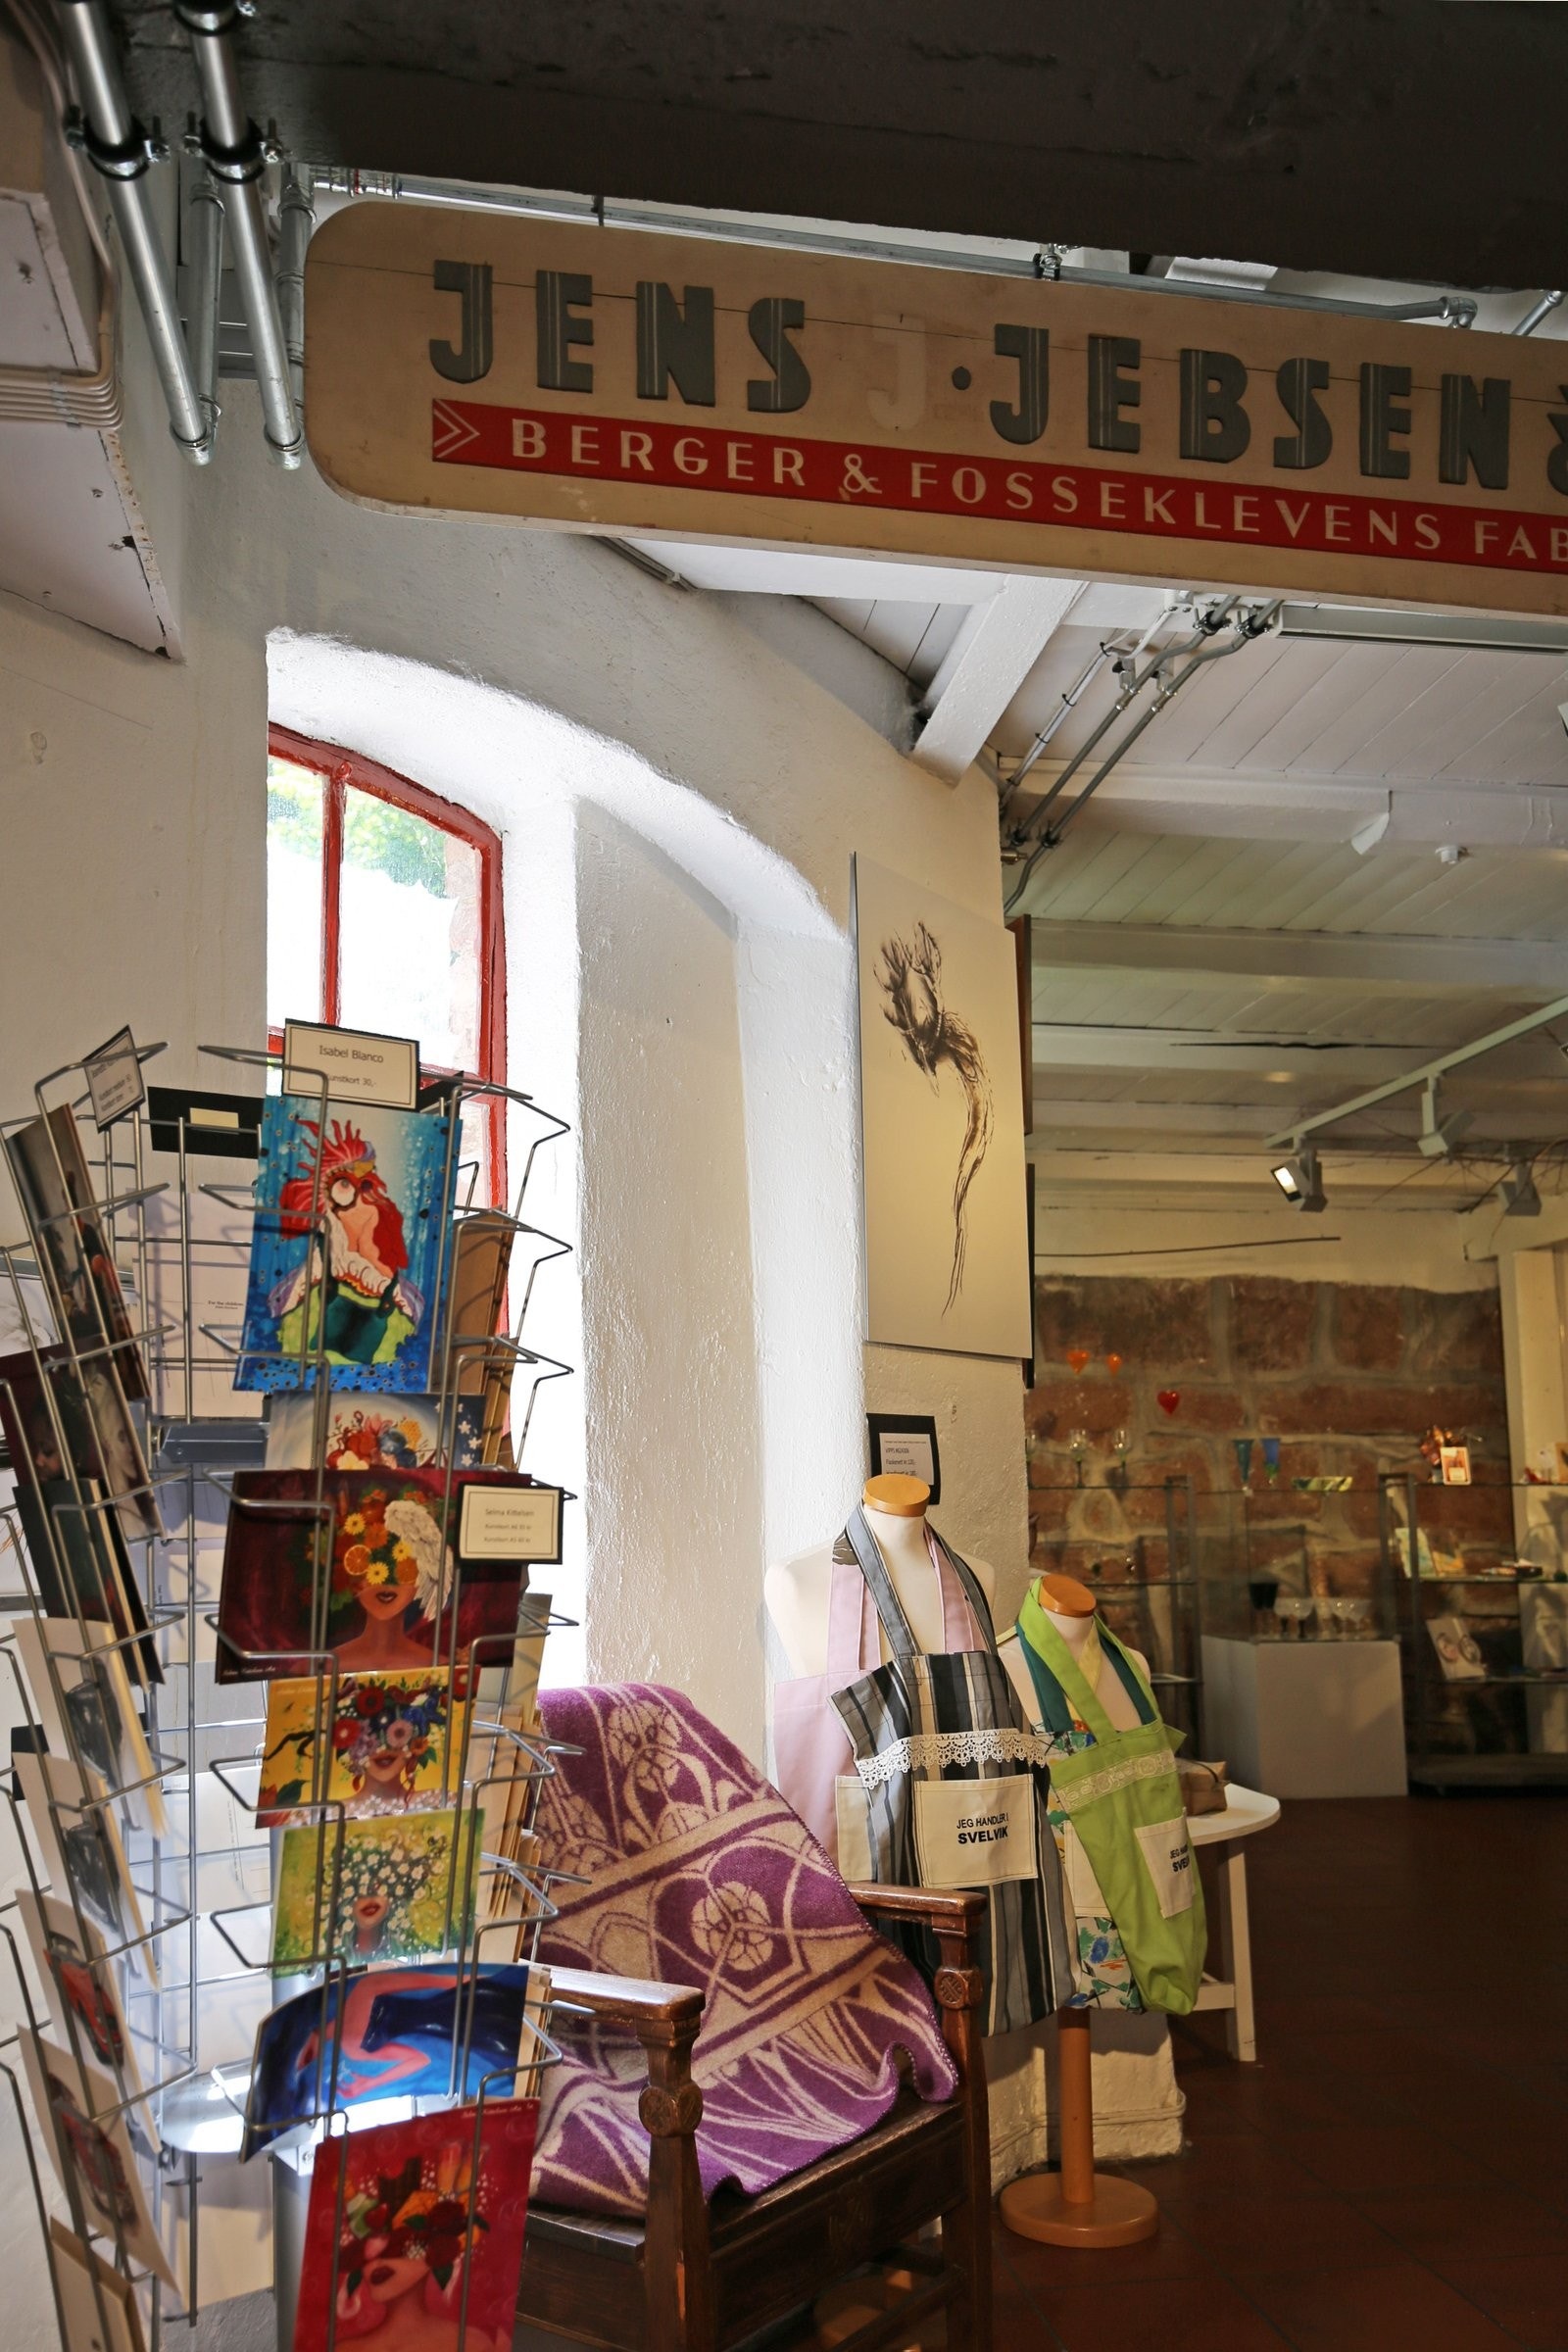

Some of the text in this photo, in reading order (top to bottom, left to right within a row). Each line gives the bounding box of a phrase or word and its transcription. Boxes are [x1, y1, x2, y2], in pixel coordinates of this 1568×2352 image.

[429, 259, 811, 413] JENS
[989, 323, 1511, 490] JEBSEN
[512, 418, 1568, 563] BERGER & FOSSEKLEVENS FAB
[319, 1046, 384, 1063] Isabel Blanco
[327, 1074, 361, 1085] unstkort
[956, 1819, 974, 1829] JEG
[975, 1812, 1005, 1827] HANDLER
[957, 1825, 1008, 1844] SVELVIK
